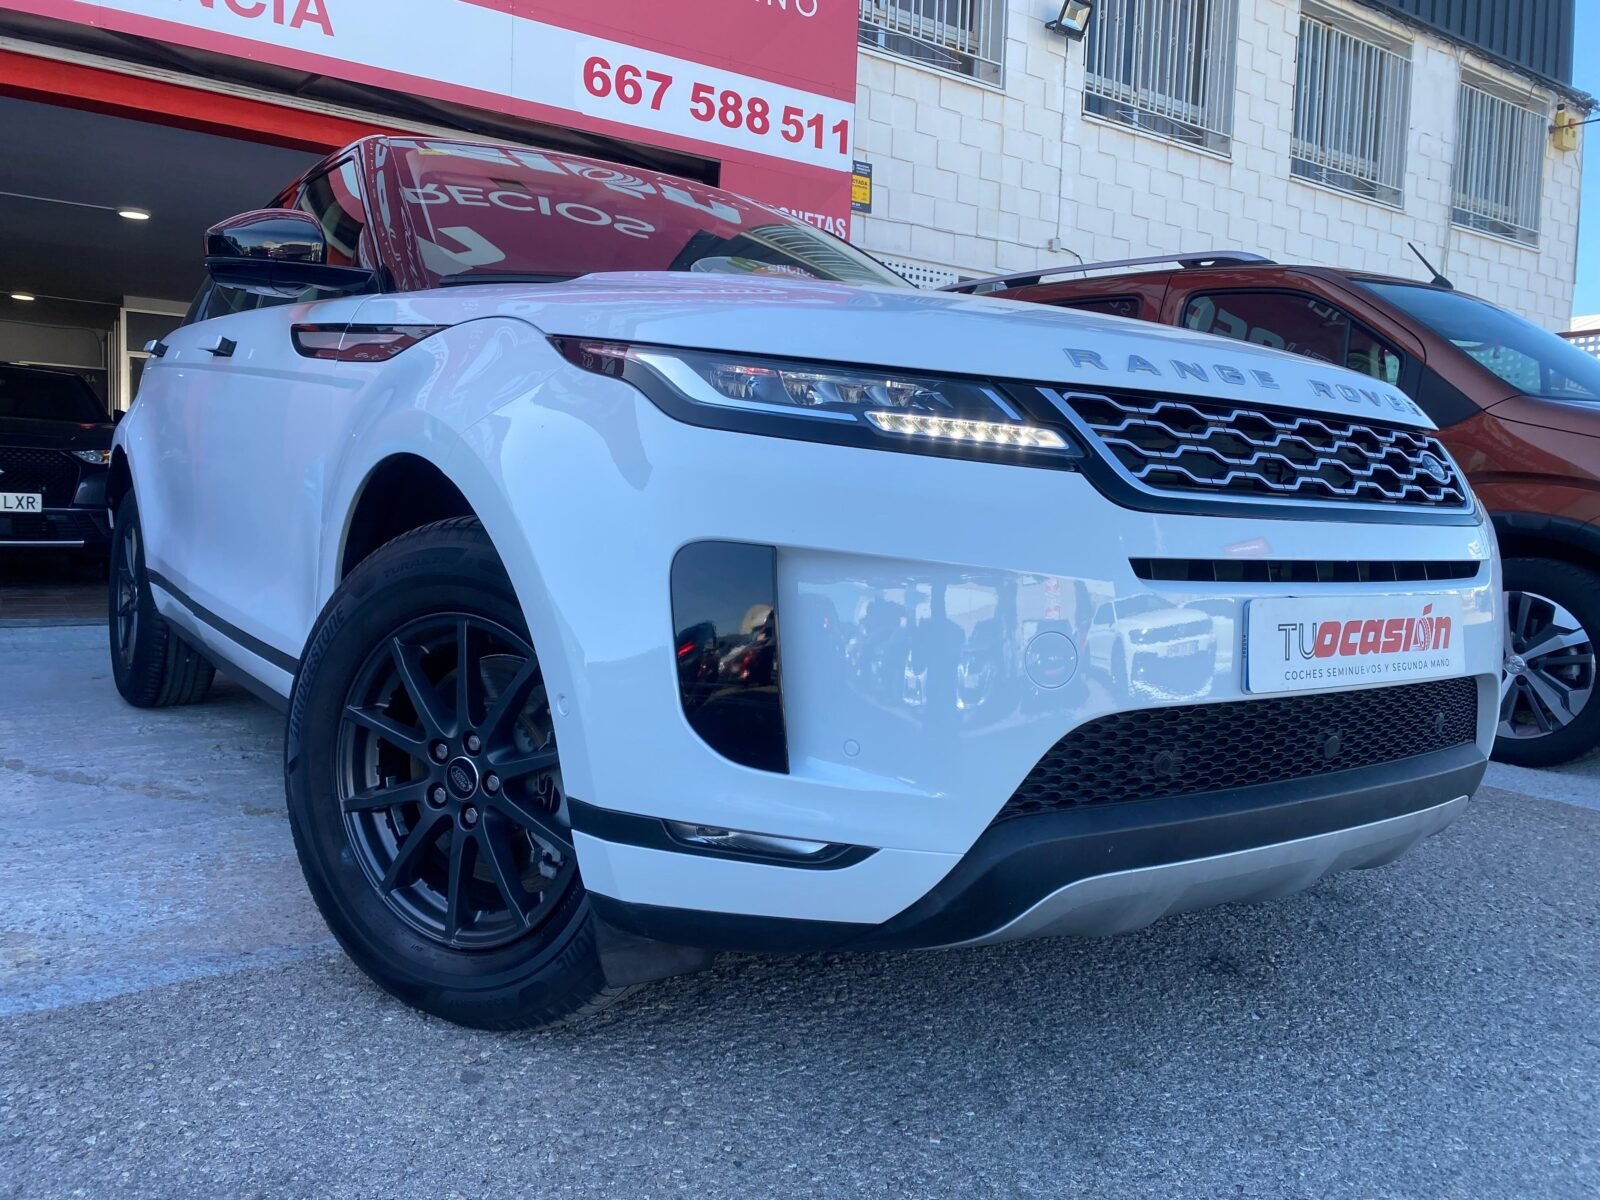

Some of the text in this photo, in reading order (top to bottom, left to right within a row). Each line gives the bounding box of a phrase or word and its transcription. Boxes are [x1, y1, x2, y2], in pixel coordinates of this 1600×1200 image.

[582, 56, 849, 155] 667 588 511
[1063, 348, 1422, 417] RANGE ROVER
[3, 495, 36, 510] LXR
[290, 606, 345, 742] BRIDGESTONE
[1284, 658, 1450, 681] COCHES SEMINUEVOS Y SEGUNDA MANO
